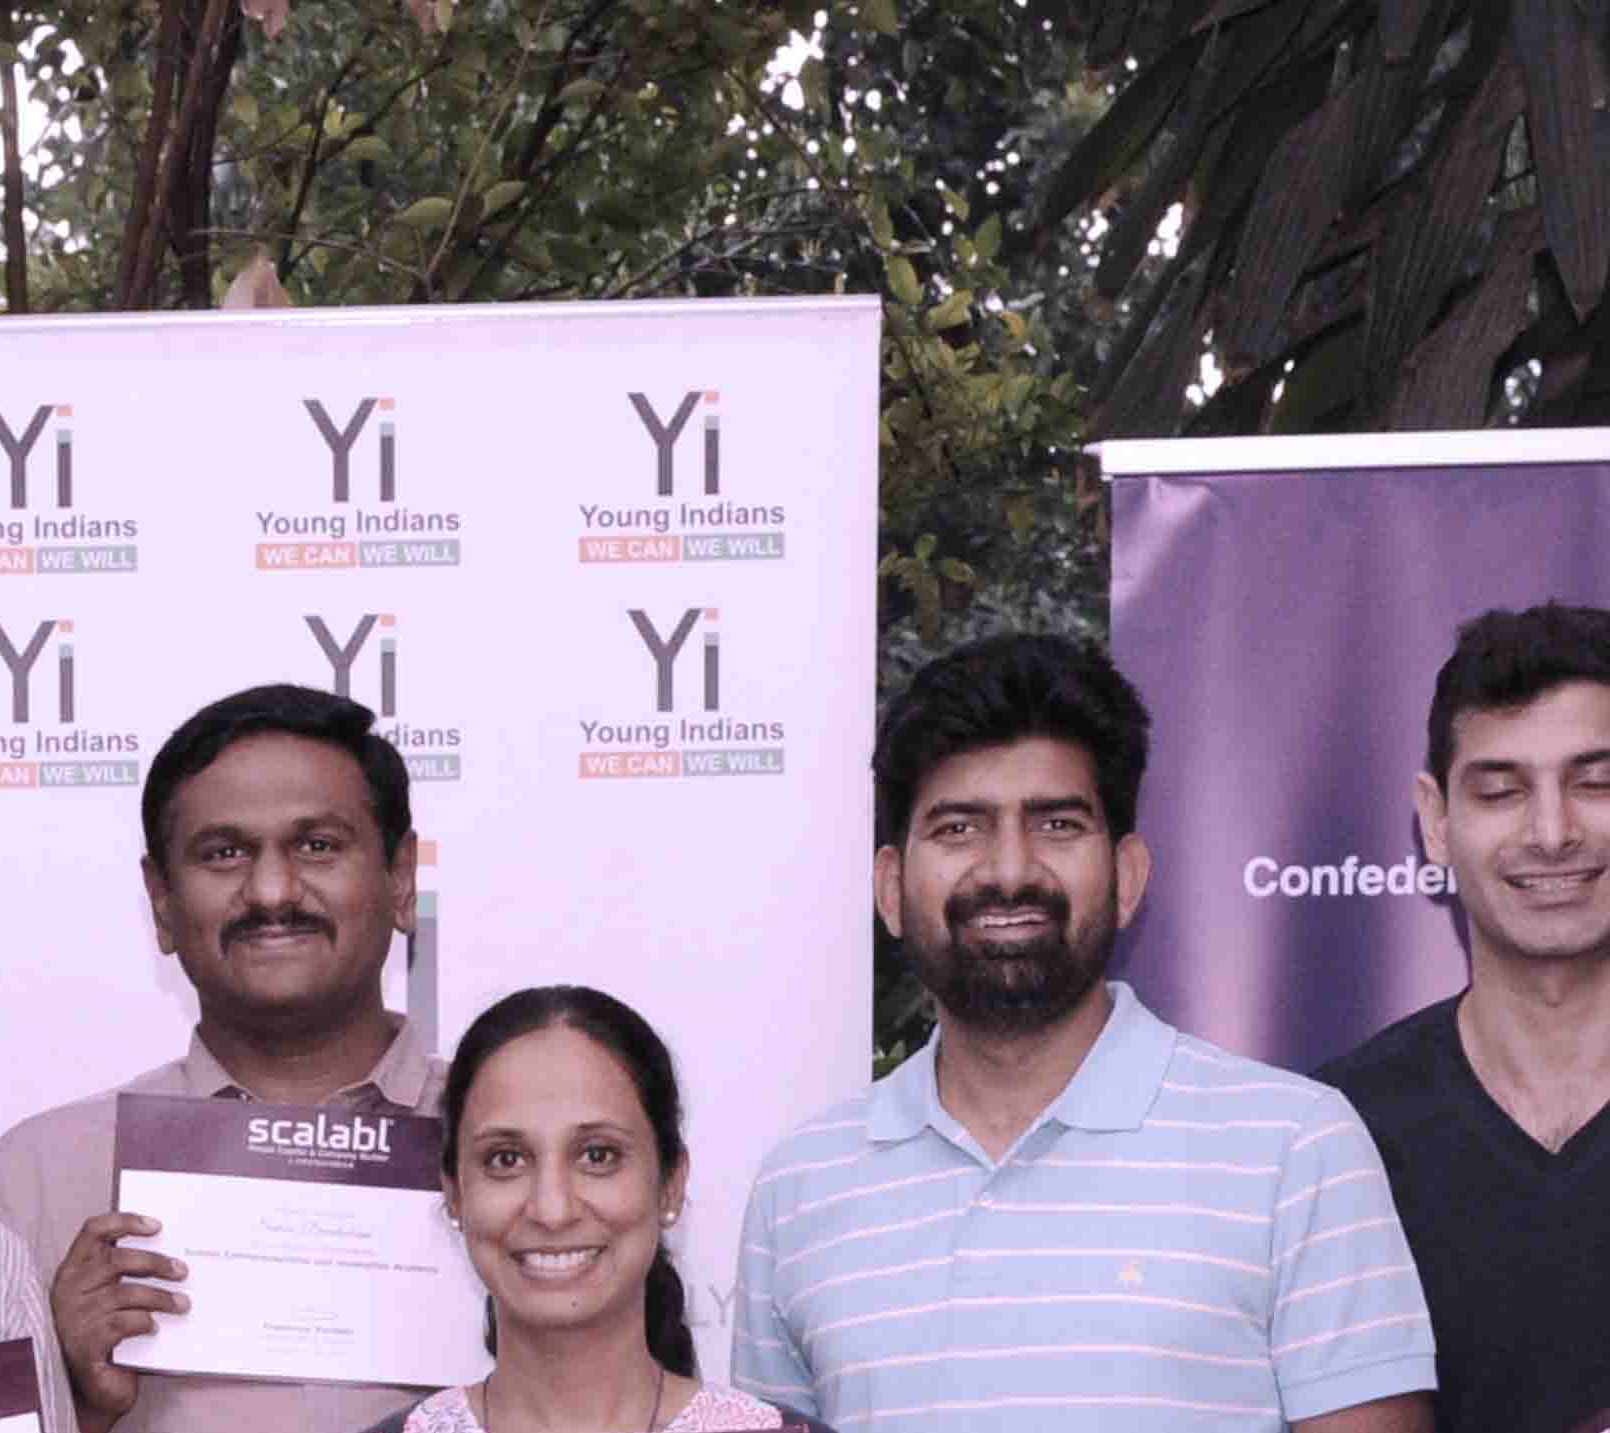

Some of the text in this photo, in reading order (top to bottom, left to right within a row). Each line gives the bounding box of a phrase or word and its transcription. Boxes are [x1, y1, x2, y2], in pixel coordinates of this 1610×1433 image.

[302, 397, 395, 502] Yi
[627, 390, 720, 496] Yi
[35, 515, 138, 539] Indians
[256, 509, 460, 539] Young Indians
[579, 501, 785, 533] Young Indians
[41, 551, 74, 568] WE
[81, 550, 136, 568] WILL
[264, 545, 457, 565] WE CAN WE WILL
[586, 538, 781, 560] WE CAN WE WILL
[303, 614, 396, 718] Yi
[627, 608, 720, 712] Yi
[36, 729, 139, 752] Indians
[381, 722, 462, 748] dians
[579, 717, 785, 748] Young Indians
[43, 767, 75, 784] WE
[80, 767, 137, 784] WILL
[586, 754, 779, 775] WE CAN WE WILL
[248, 1113, 390, 1153] scalabl
